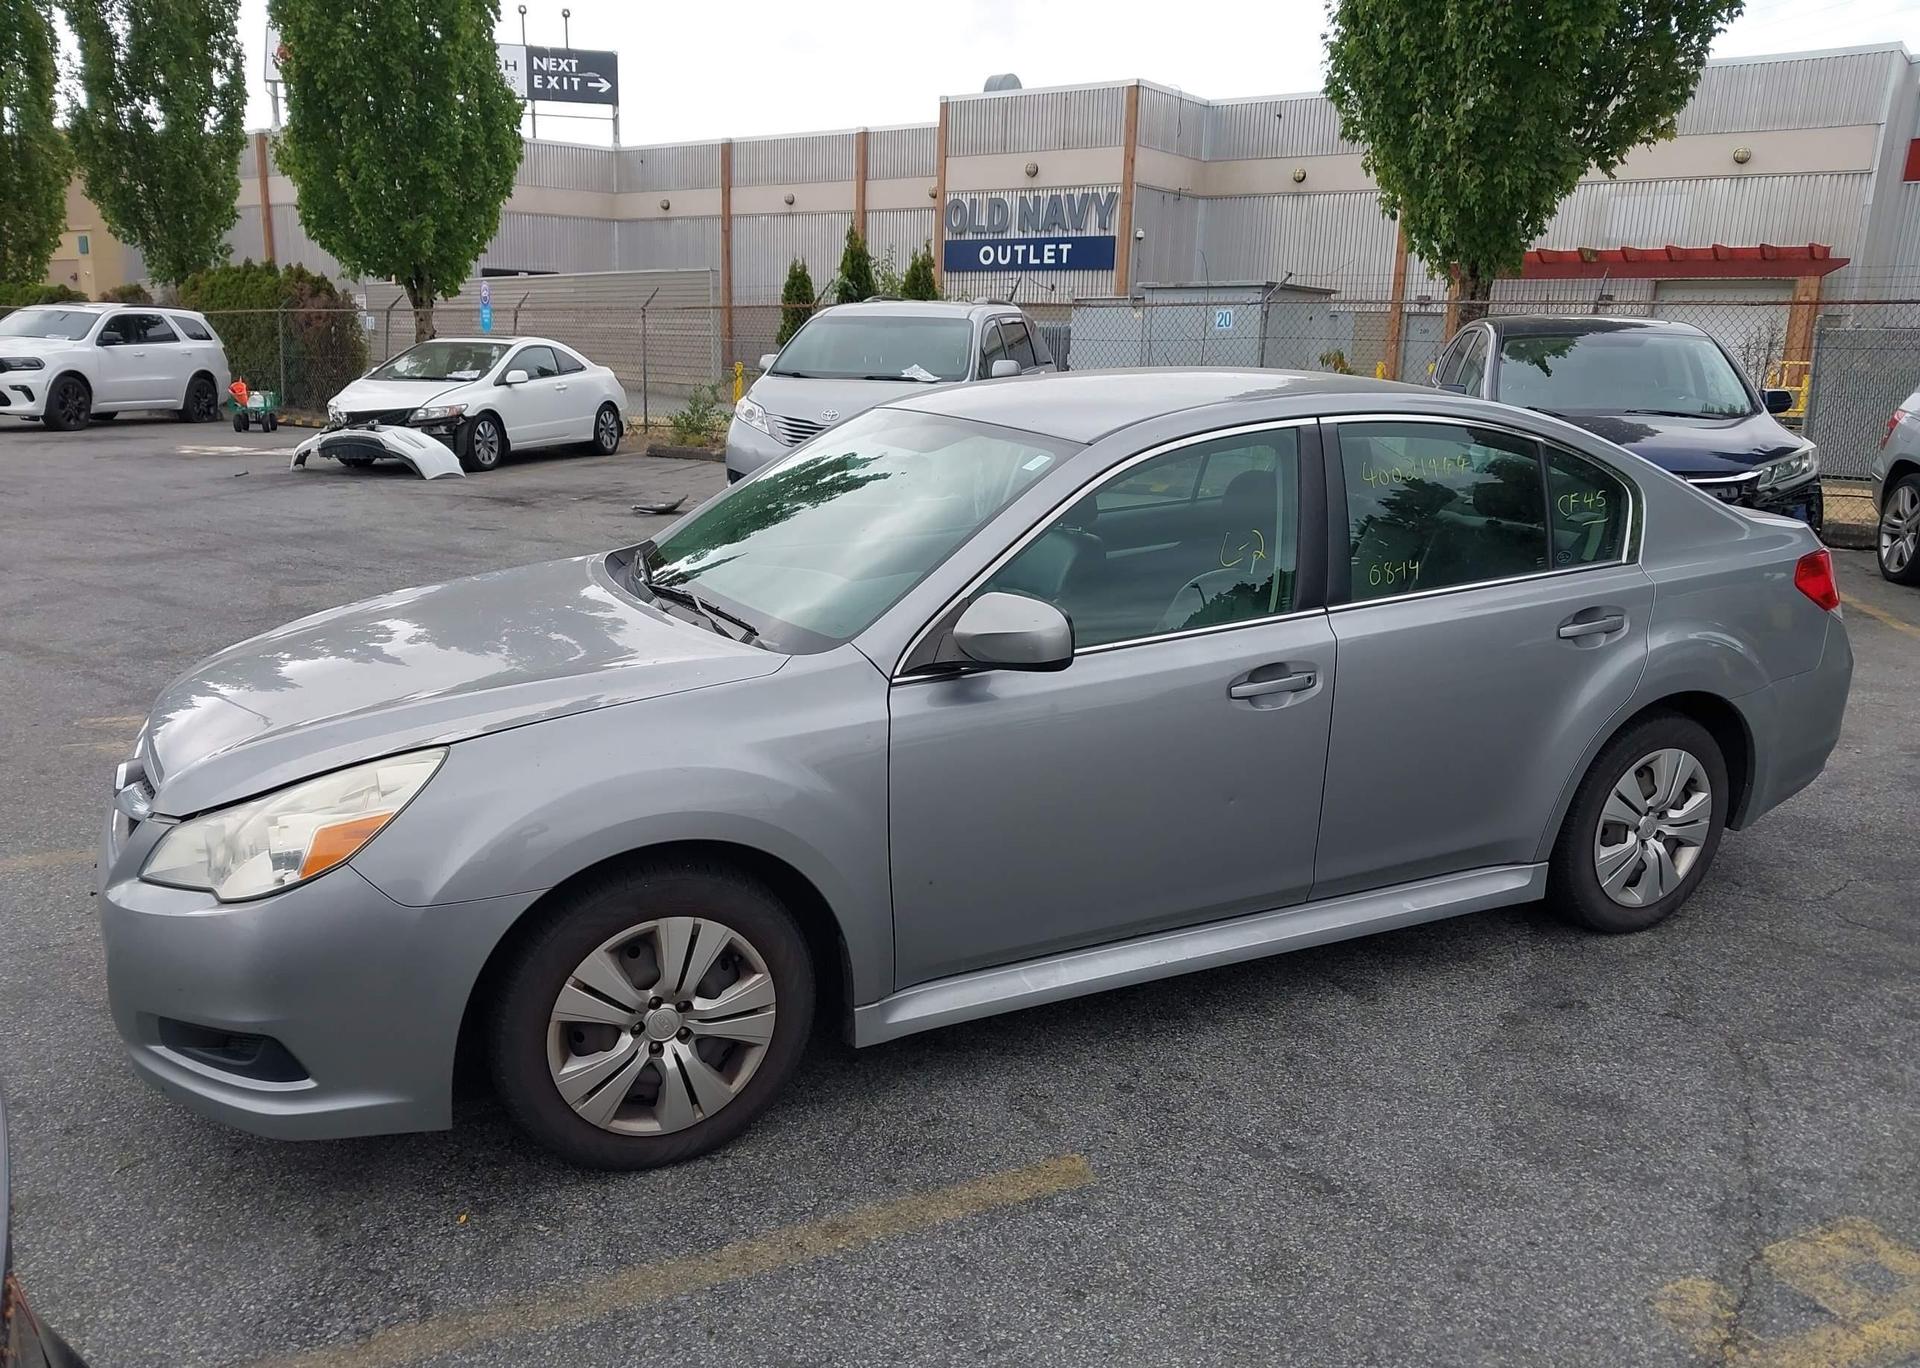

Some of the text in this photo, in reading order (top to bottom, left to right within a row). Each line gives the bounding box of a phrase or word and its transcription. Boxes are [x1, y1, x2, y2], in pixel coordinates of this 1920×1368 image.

[533, 56, 578, 72] NEXT
[533, 75, 580, 90] EXIT
[945, 192, 1118, 233] OLD NAVY
[979, 244, 1072, 265] OUTLET
[1217, 311, 1231, 327] 20
